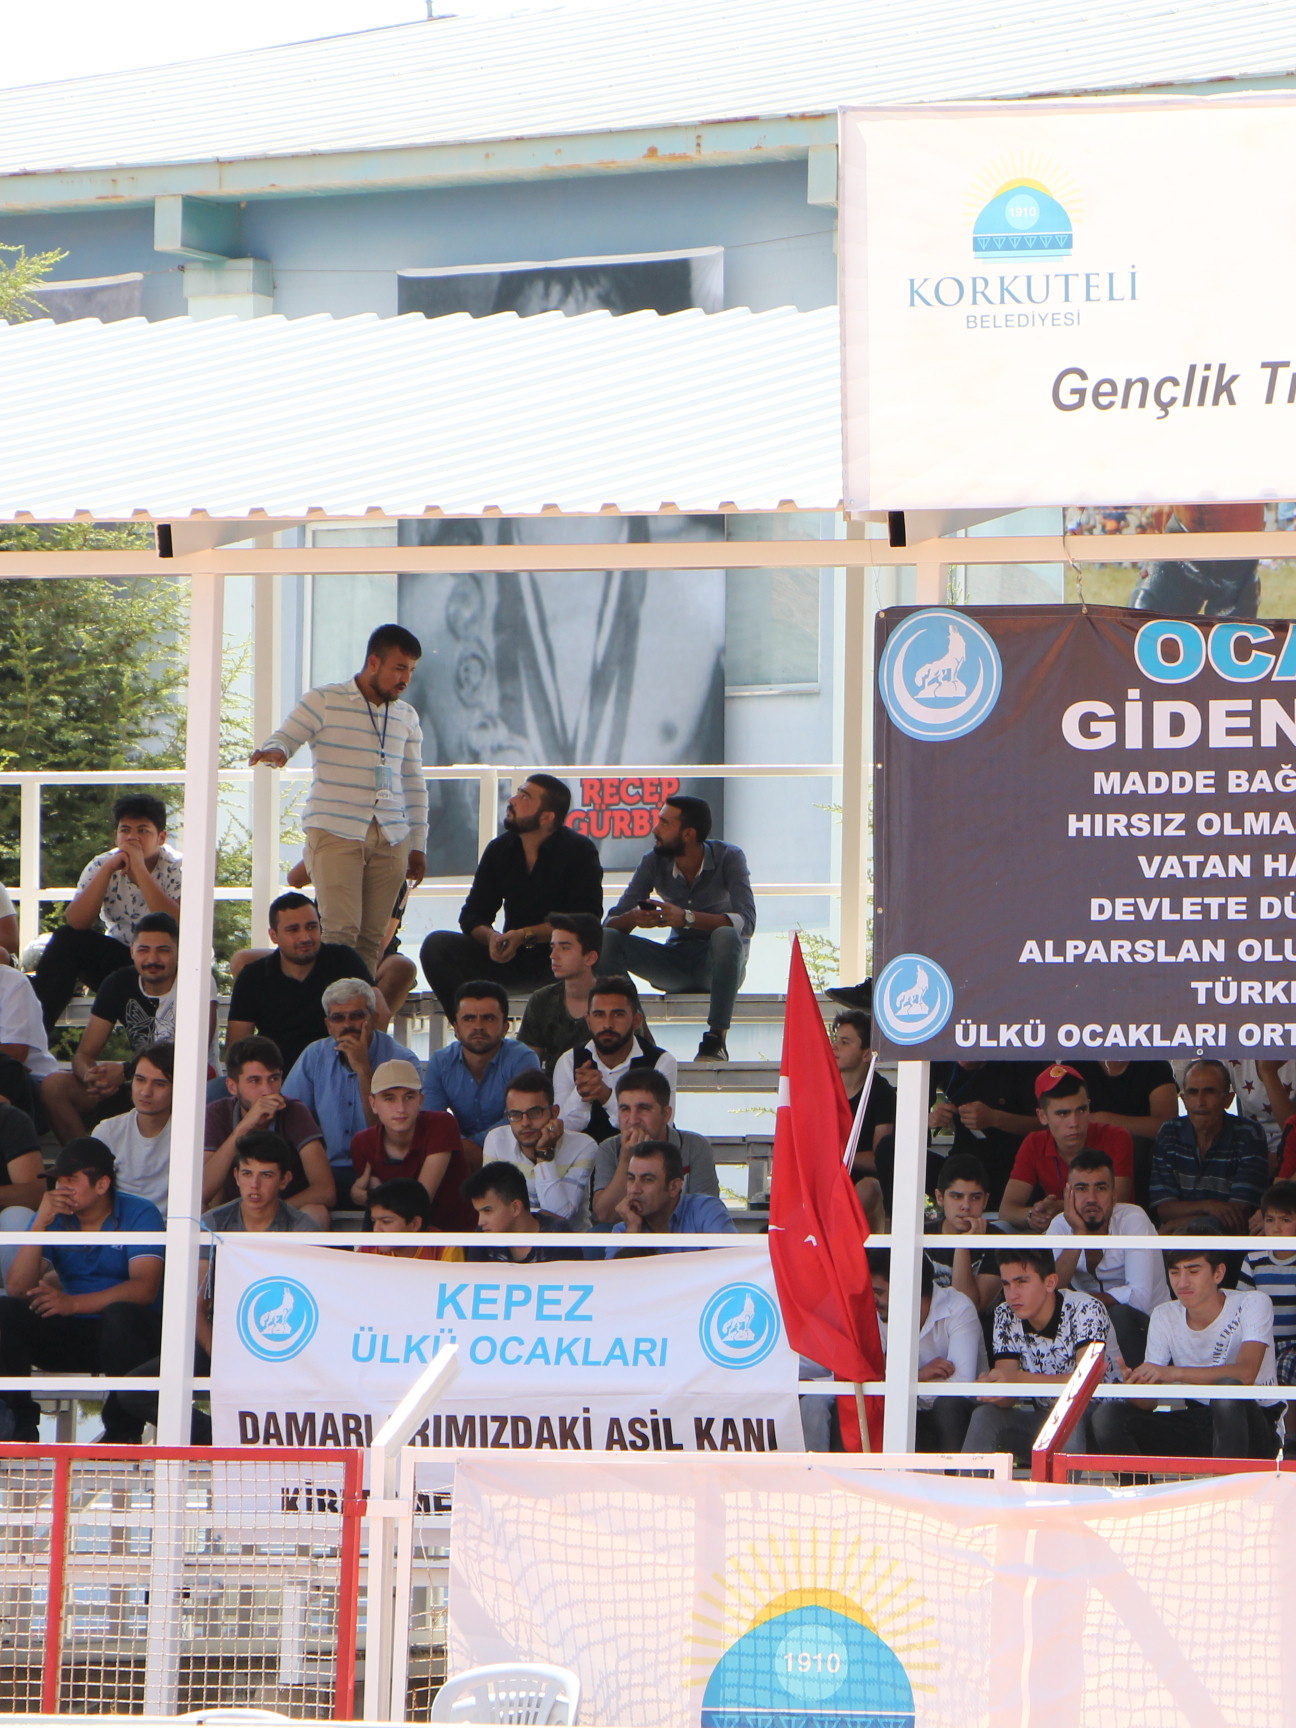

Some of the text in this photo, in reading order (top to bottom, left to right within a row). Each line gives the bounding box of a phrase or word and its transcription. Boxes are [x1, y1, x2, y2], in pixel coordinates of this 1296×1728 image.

[1008, 207, 1036, 218] 1910
[907, 264, 1141, 308] KORKUTELİ
[966, 309, 1082, 330] BELEDİYESİ
[1051, 362, 1241, 420] Gençlik
[580, 778, 680, 806] RECEP
[1093, 770, 1216, 795] MADDE
[1067, 813, 1187, 837] HIRSIZ
[1137, 854, 1251, 879] VATAN
[1090, 896, 1248, 921] DEVLETE
[1018, 938, 1226, 964] ALPARSLAN
[954, 1018, 1046, 1048] ÜLKÜ
[1057, 1023, 1227, 1048] OCAKLARI
[435, 1282, 594, 1322] KEPEZ
[469, 1335, 668, 1367] OCAKLARI
[605, 1408, 683, 1451] ASİL
[694, 1417, 778, 1452] KANI
[783, 1652, 840, 1673] 1910
